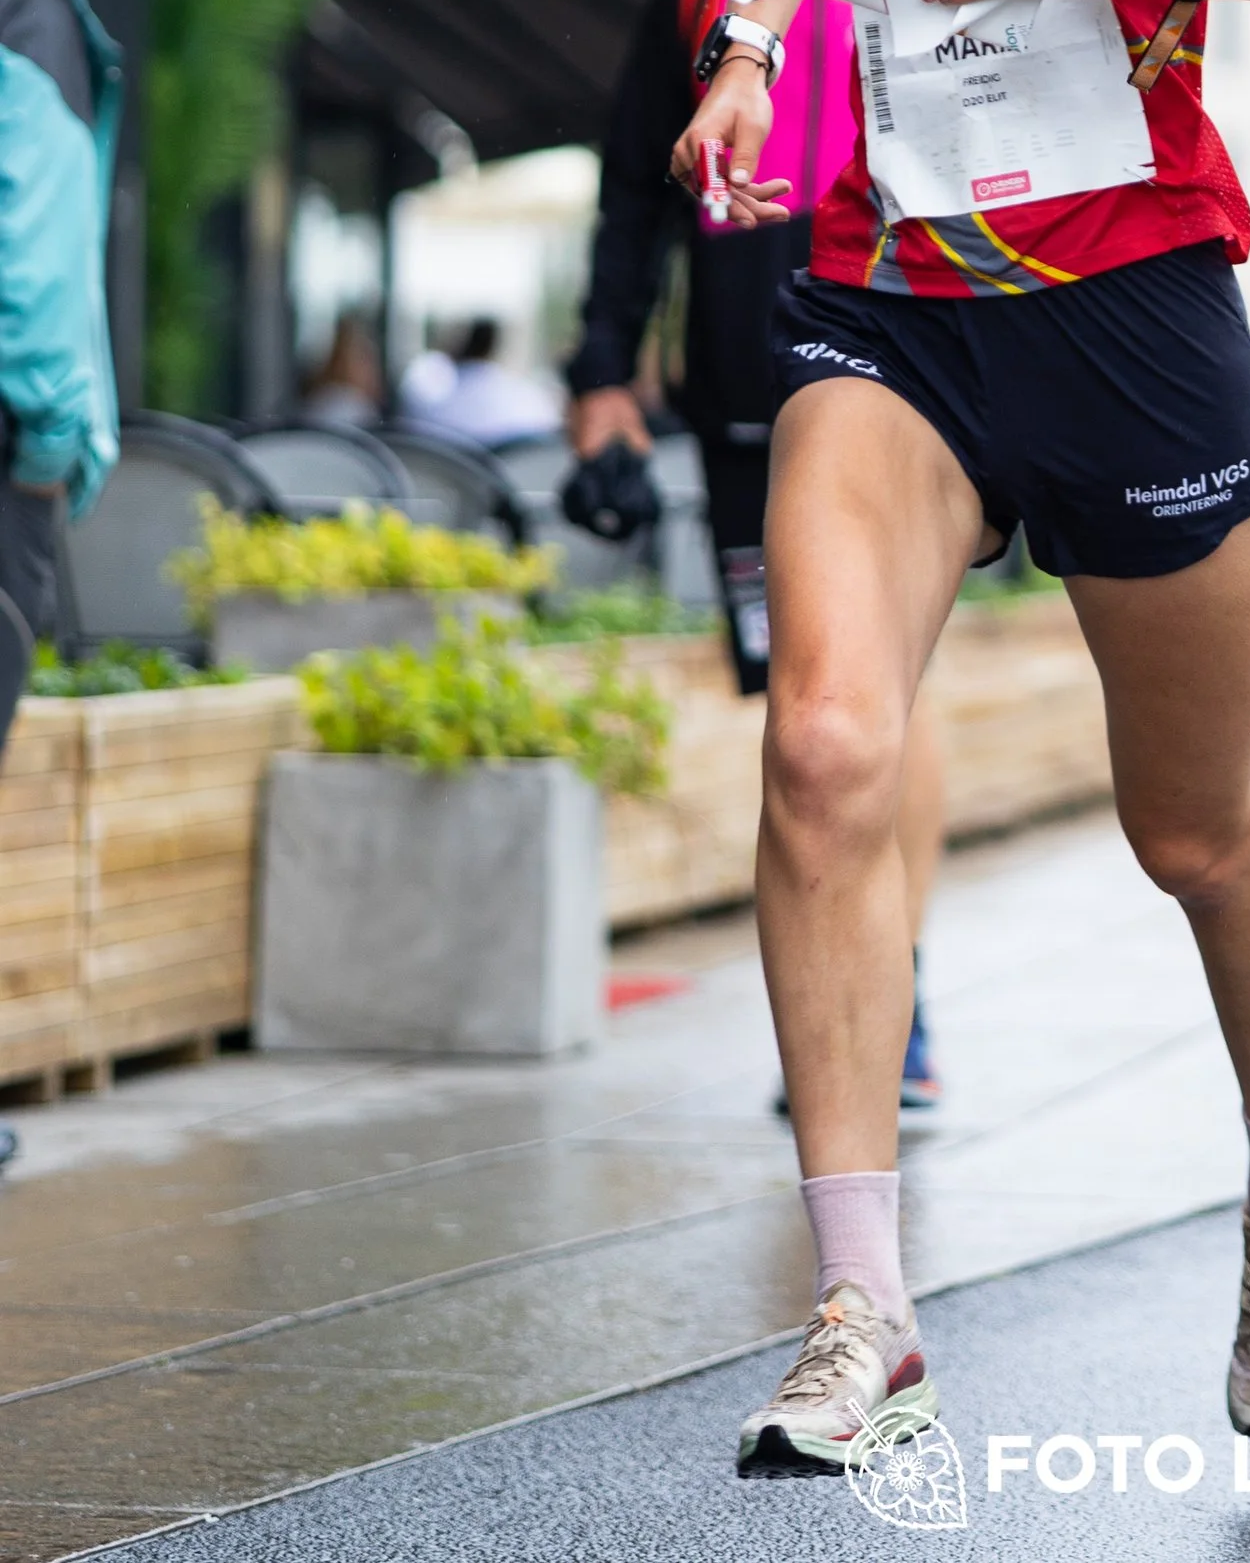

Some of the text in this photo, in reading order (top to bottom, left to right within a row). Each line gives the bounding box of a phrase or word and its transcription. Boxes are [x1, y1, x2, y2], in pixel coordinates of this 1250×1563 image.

[1125, 459, 1250, 504] Heimdal VGS
[1152, 489, 1233, 517] ORIENTERING
